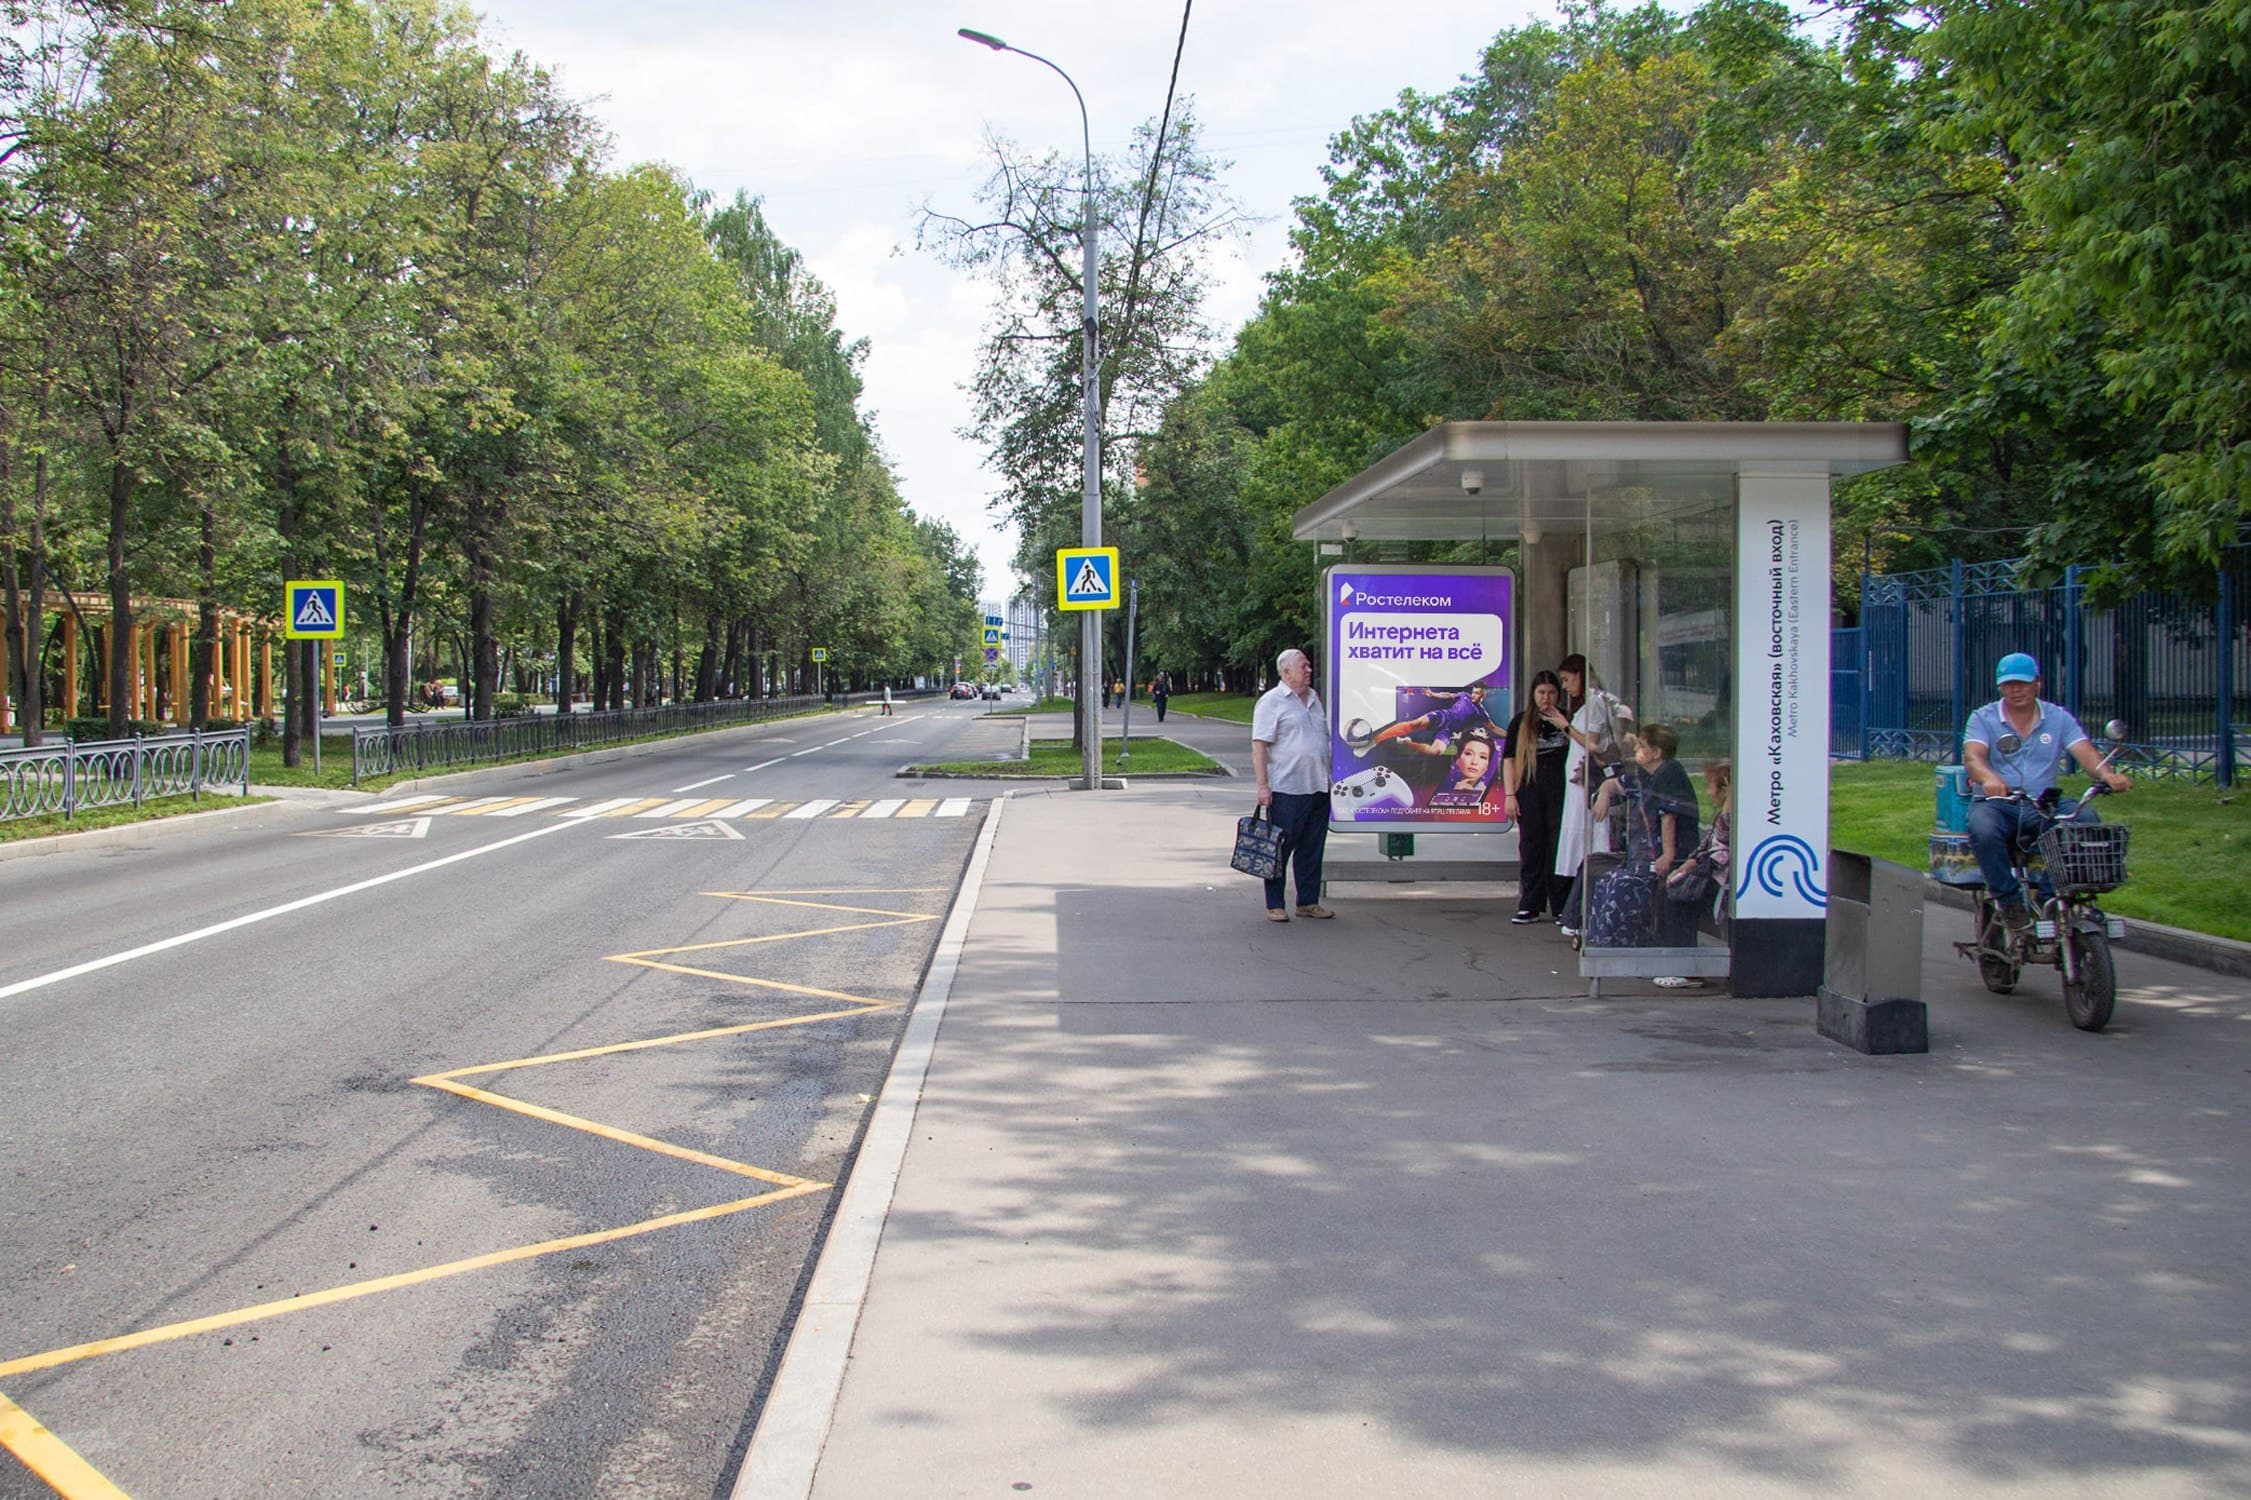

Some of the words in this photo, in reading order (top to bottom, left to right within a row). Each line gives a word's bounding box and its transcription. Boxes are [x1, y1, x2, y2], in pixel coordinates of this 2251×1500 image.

[1766, 519, 1784, 562] вход)
[1787, 519, 1799, 573] Entrance)
[1356, 592, 1451, 607] Ростелеком
[1767, 568, 1783, 658] (восточный
[1787, 576, 1799, 623] (Eastern
[1348, 621, 1460, 643] Интернета
[1348, 645, 1415, 659] хватит
[1420, 645, 1443, 660] на
[1448, 643, 1483, 660] всё
[1787, 626, 1799, 699] Kakhovskaya
[1767, 663, 1782, 765] «Каховская»
[1787, 702, 1799, 738] Metro
[1478, 801, 1500, 816] 18+
[1767, 770, 1784, 825] Метро
